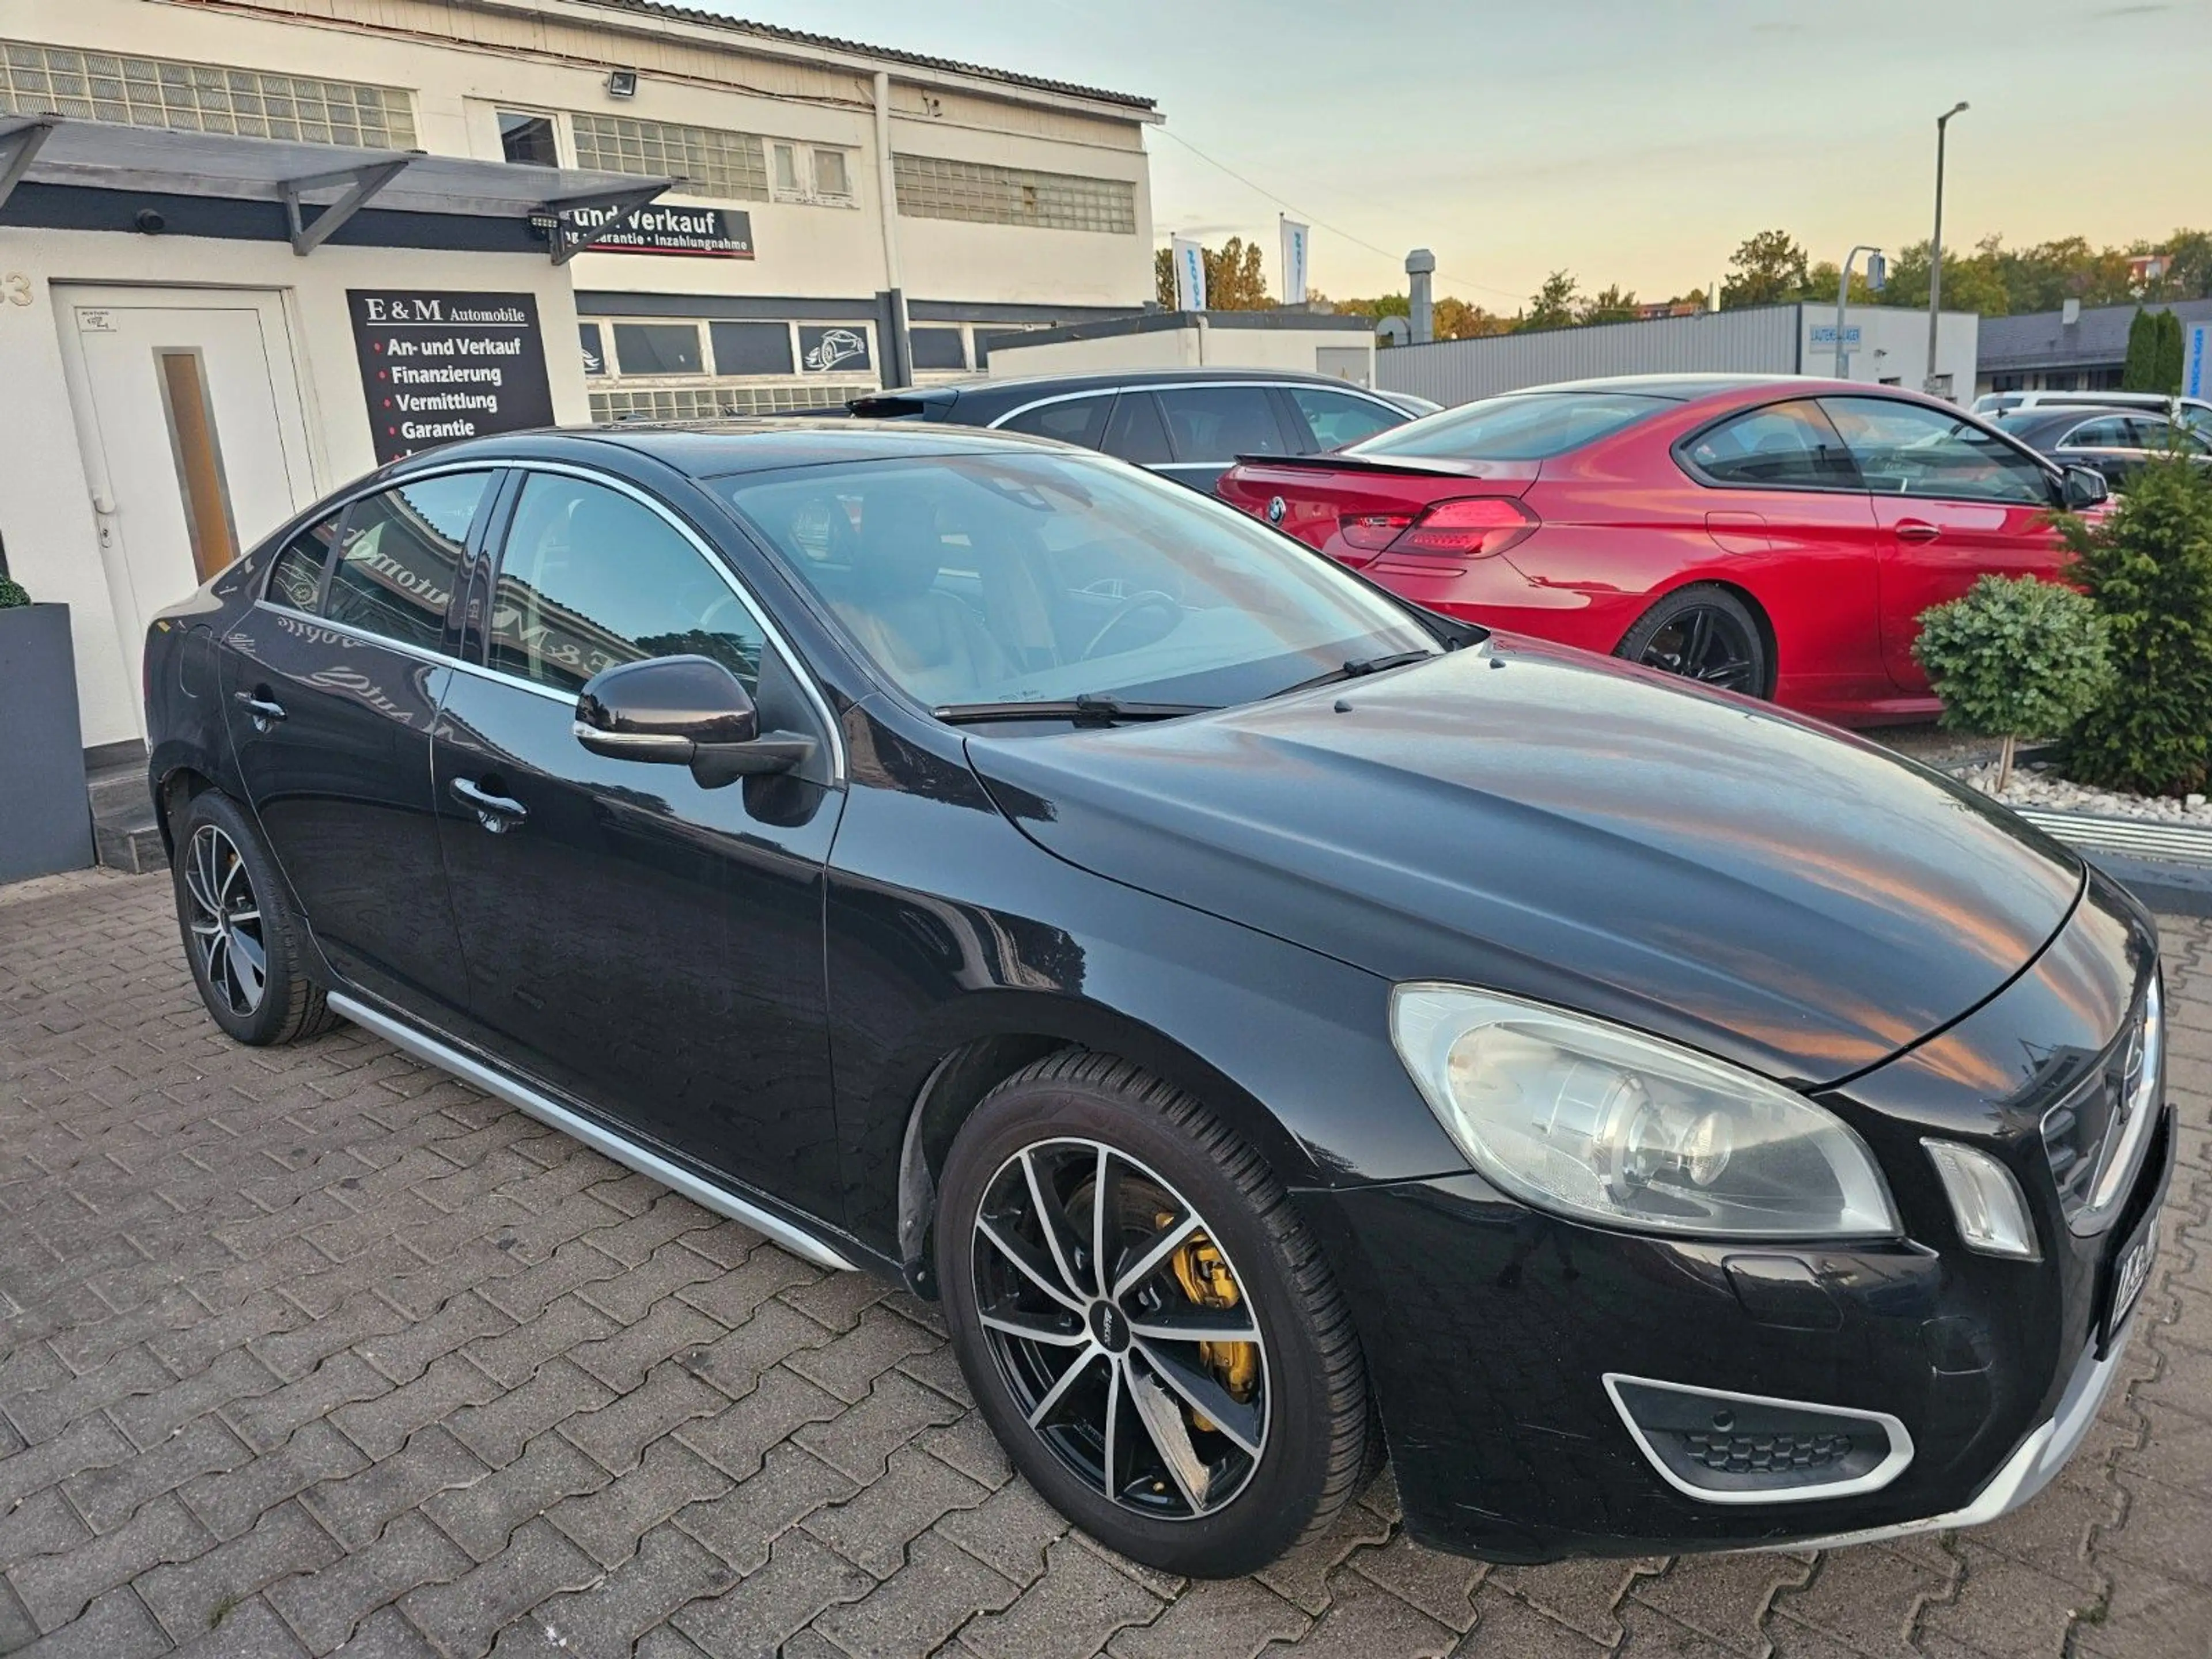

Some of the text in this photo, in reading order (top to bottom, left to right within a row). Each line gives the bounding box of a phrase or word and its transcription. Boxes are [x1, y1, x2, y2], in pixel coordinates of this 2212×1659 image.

[628, 209, 715, 234] Verkauf
[594, 233, 645, 245] arantie
[654, 233, 748, 251] Inzahlungnahme
[365, 298, 525, 322] E & M Automobile
[387, 338, 521, 355] An- und Verkauf
[391, 365, 502, 386] Finanzierung
[395, 392, 498, 413] Vermittlung
[401, 419, 475, 439] Garantie
